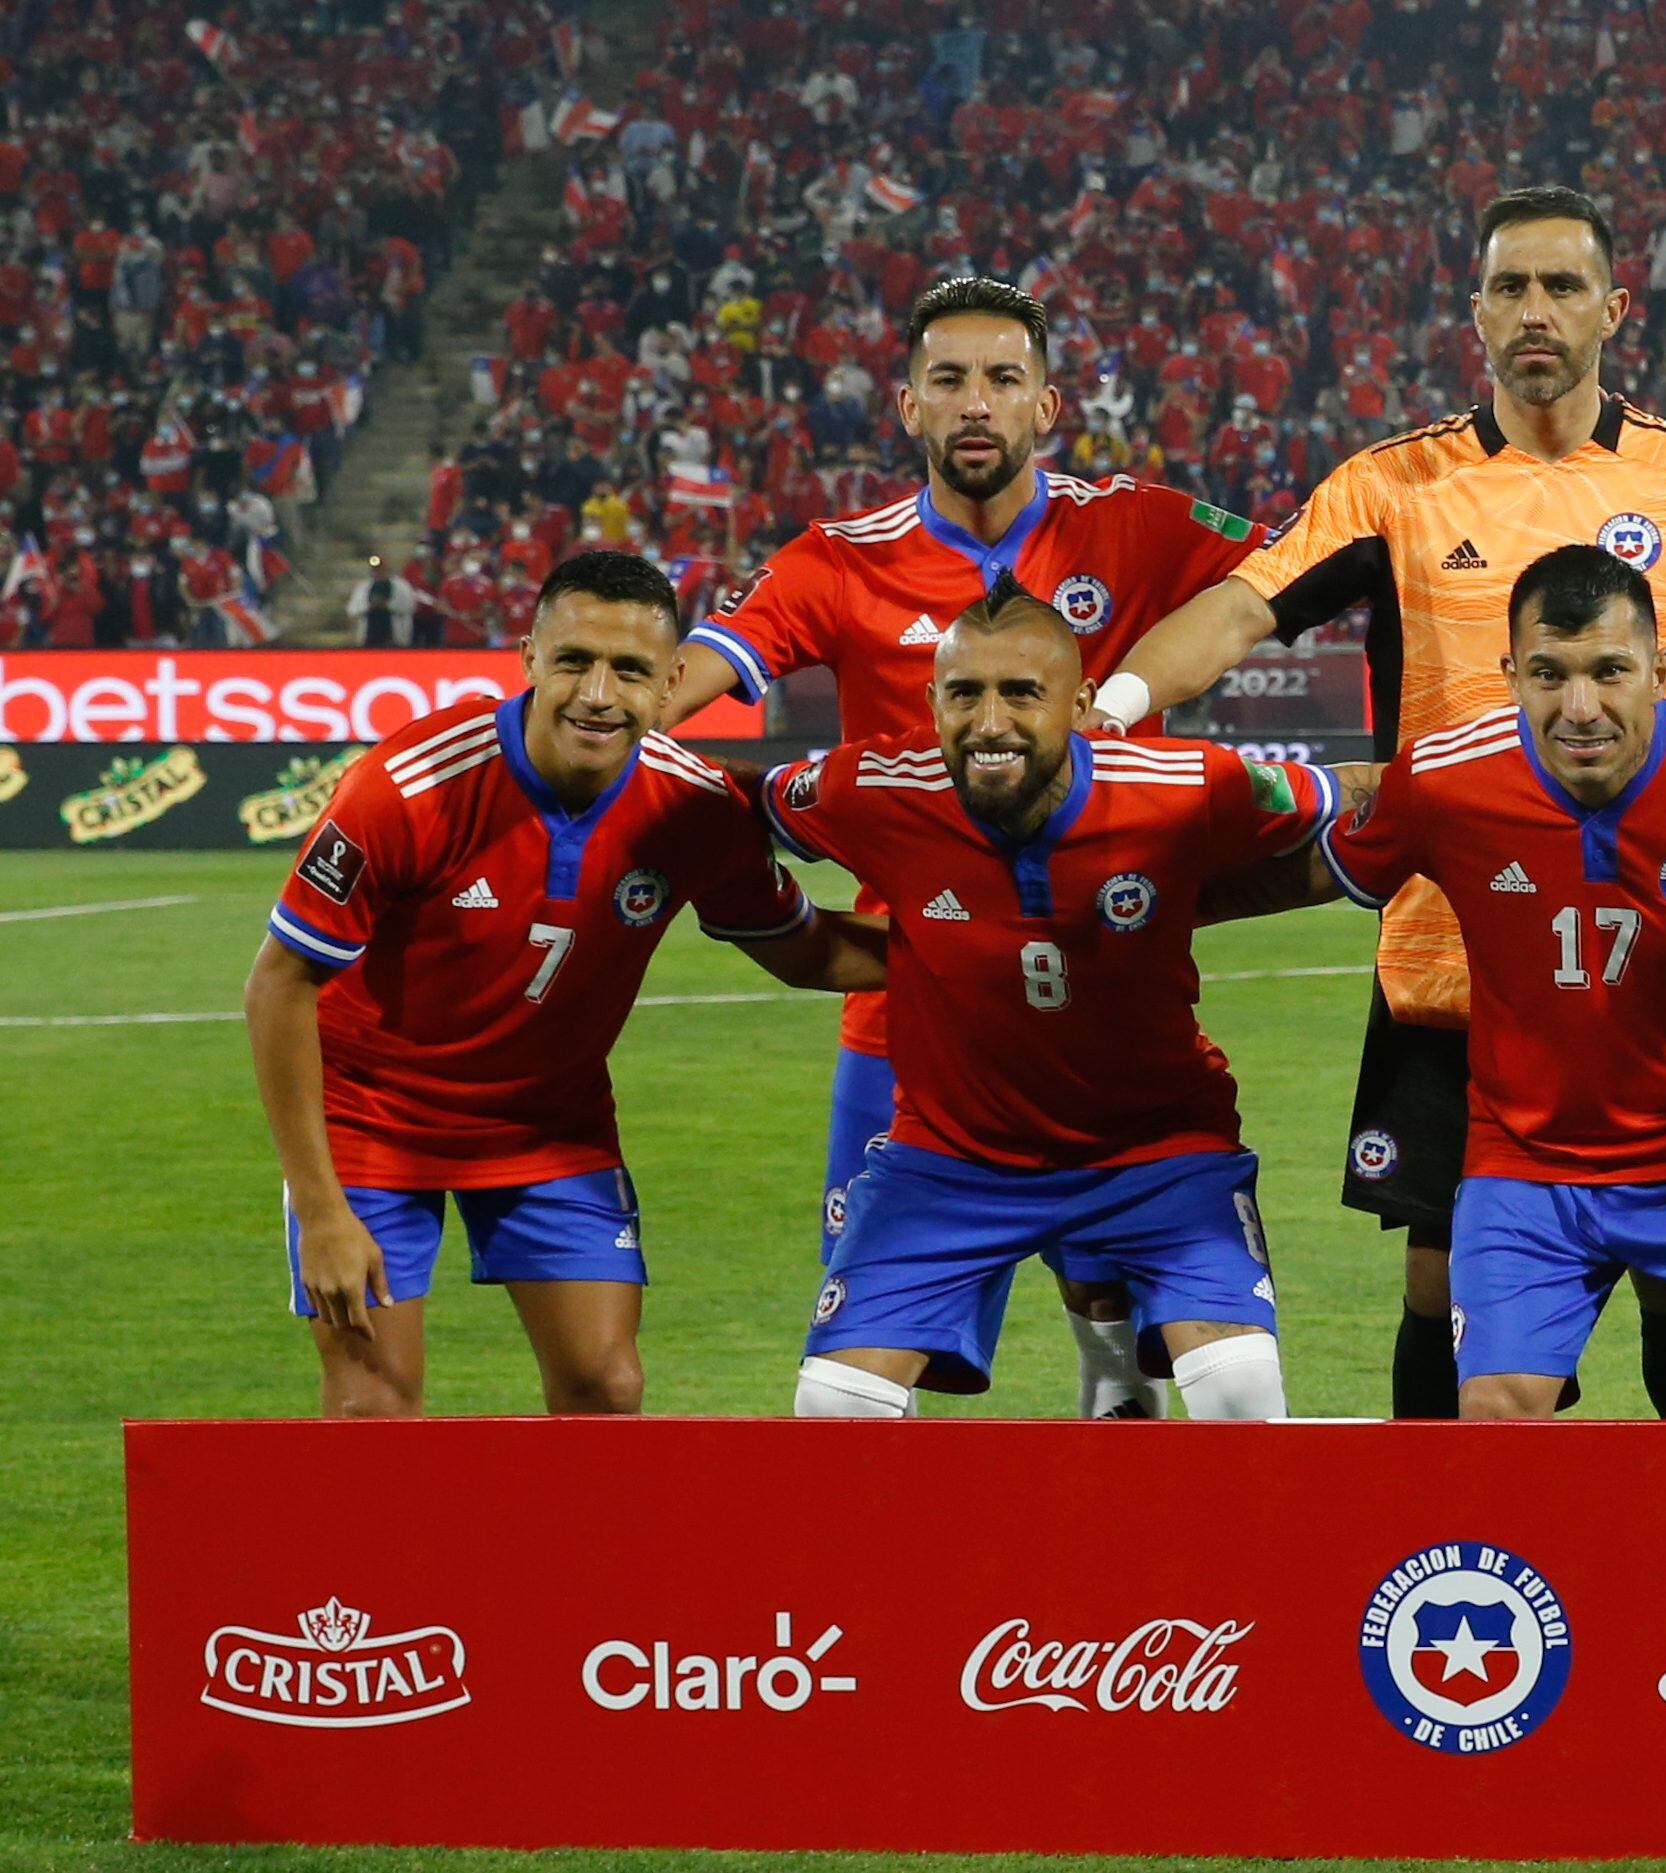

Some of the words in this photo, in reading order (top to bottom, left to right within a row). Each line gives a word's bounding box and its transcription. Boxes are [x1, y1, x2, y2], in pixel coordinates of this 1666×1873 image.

[1441, 557, 1487, 570] adidas
[452, 894, 499, 908] adidas
[922, 905, 970, 920] adidas
[1490, 880, 1537, 893] adidas
[524, 922, 575, 1004] 7
[1020, 941, 1071, 1012] 8
[1552, 906, 1641, 989] 17
[1361, 1544, 1461, 1648] FEDERACION
[1478, 1546, 1508, 1574] DE
[1514, 1566, 1569, 1650] FUTBOL
[225, 1646, 445, 1708] CRISTAL
[582, 1639, 812, 1712] Claro
[960, 1618, 1255, 1713] Coca-Cola
[1413, 1716, 1443, 1749] DE
[1457, 1716, 1524, 1753] CHILE
